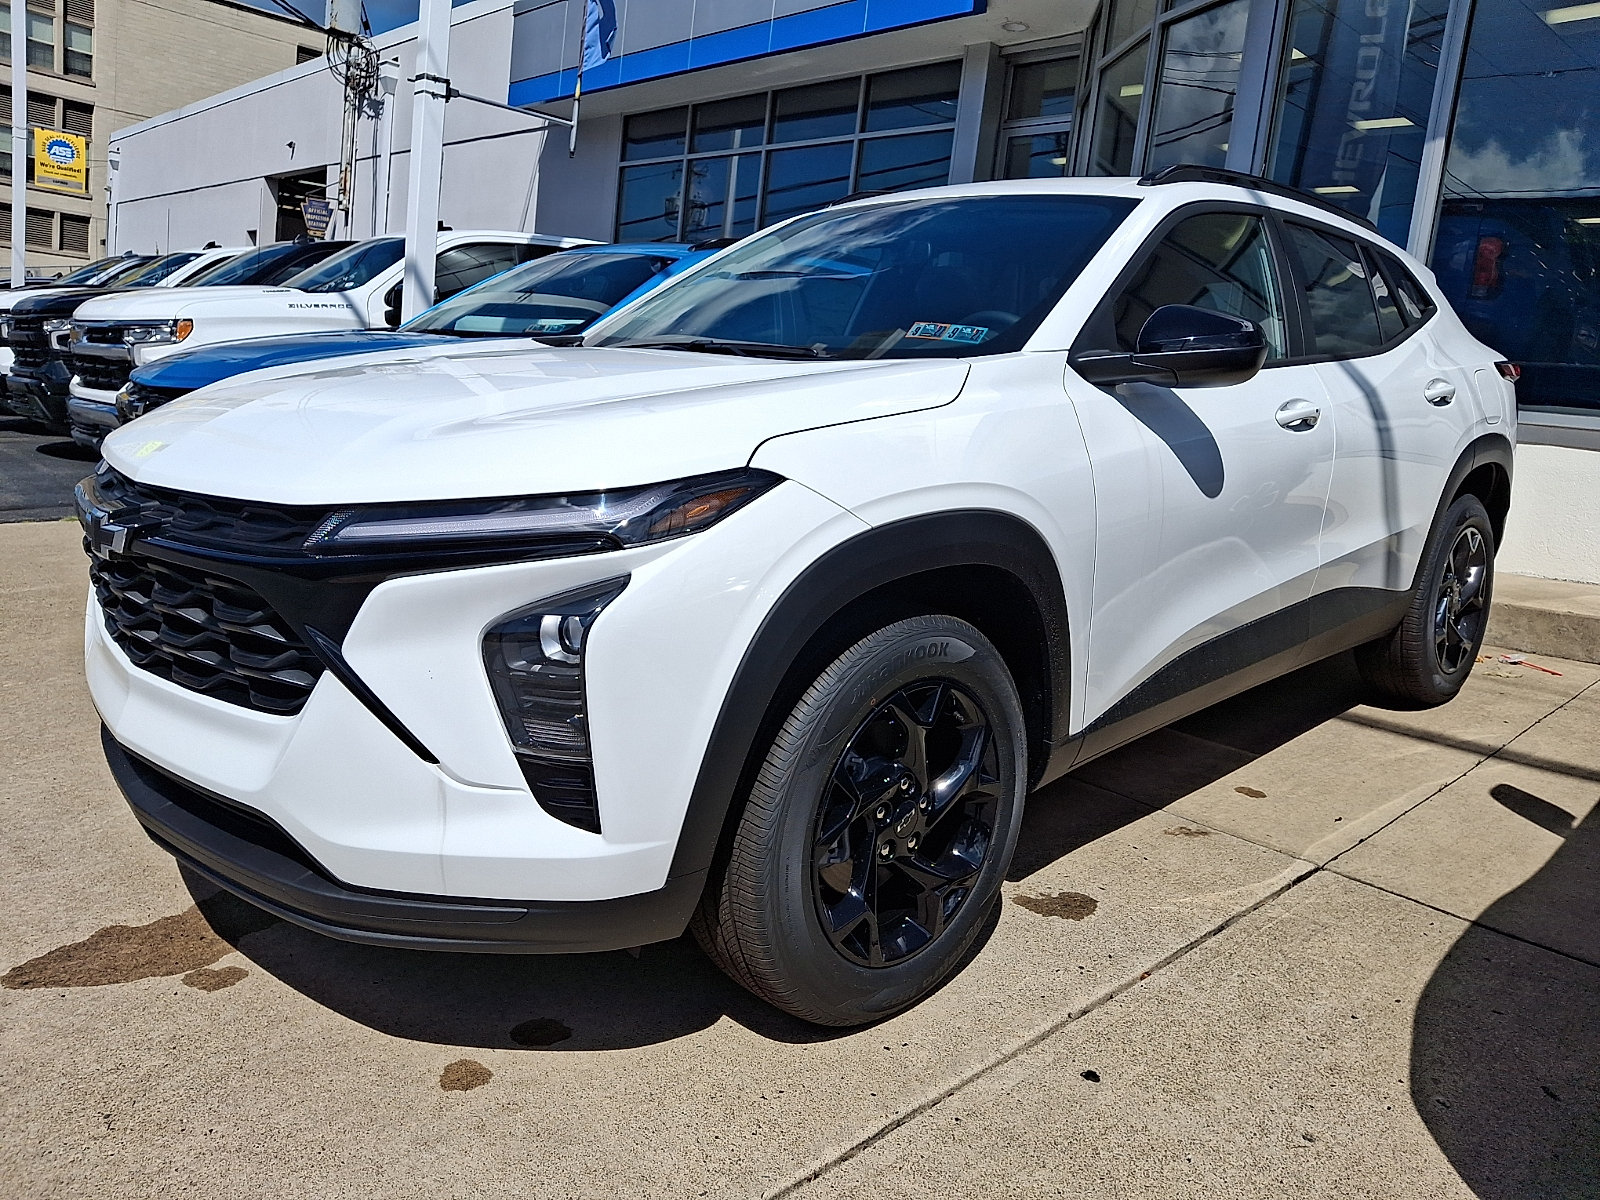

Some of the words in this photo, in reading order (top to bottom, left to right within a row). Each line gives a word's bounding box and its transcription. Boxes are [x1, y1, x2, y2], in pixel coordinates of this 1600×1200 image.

[50, 145, 72, 158] ASE
[40, 161, 55, 169] We're
[56, 165, 82, 174] Qualified!
[308, 207, 328, 215] OFFICIAL
[308, 220, 326, 228] STATION
